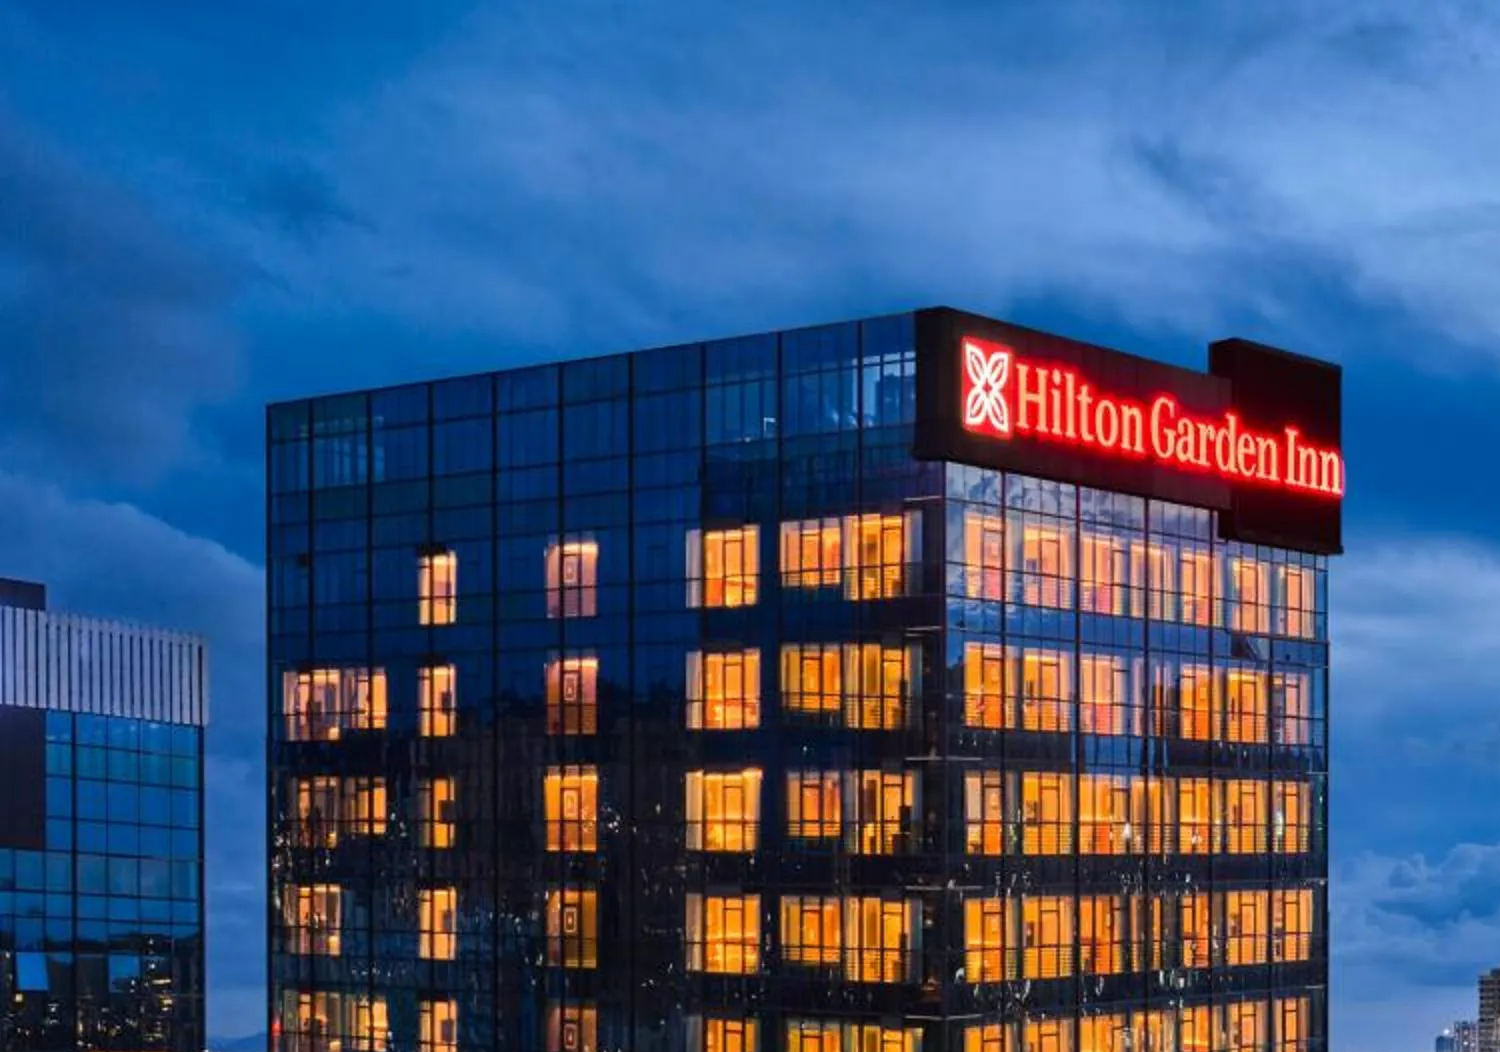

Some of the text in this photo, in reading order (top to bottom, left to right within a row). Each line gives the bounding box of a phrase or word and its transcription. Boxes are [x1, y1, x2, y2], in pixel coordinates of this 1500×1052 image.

[1016, 363, 1343, 495] Hilton Garden Inn
